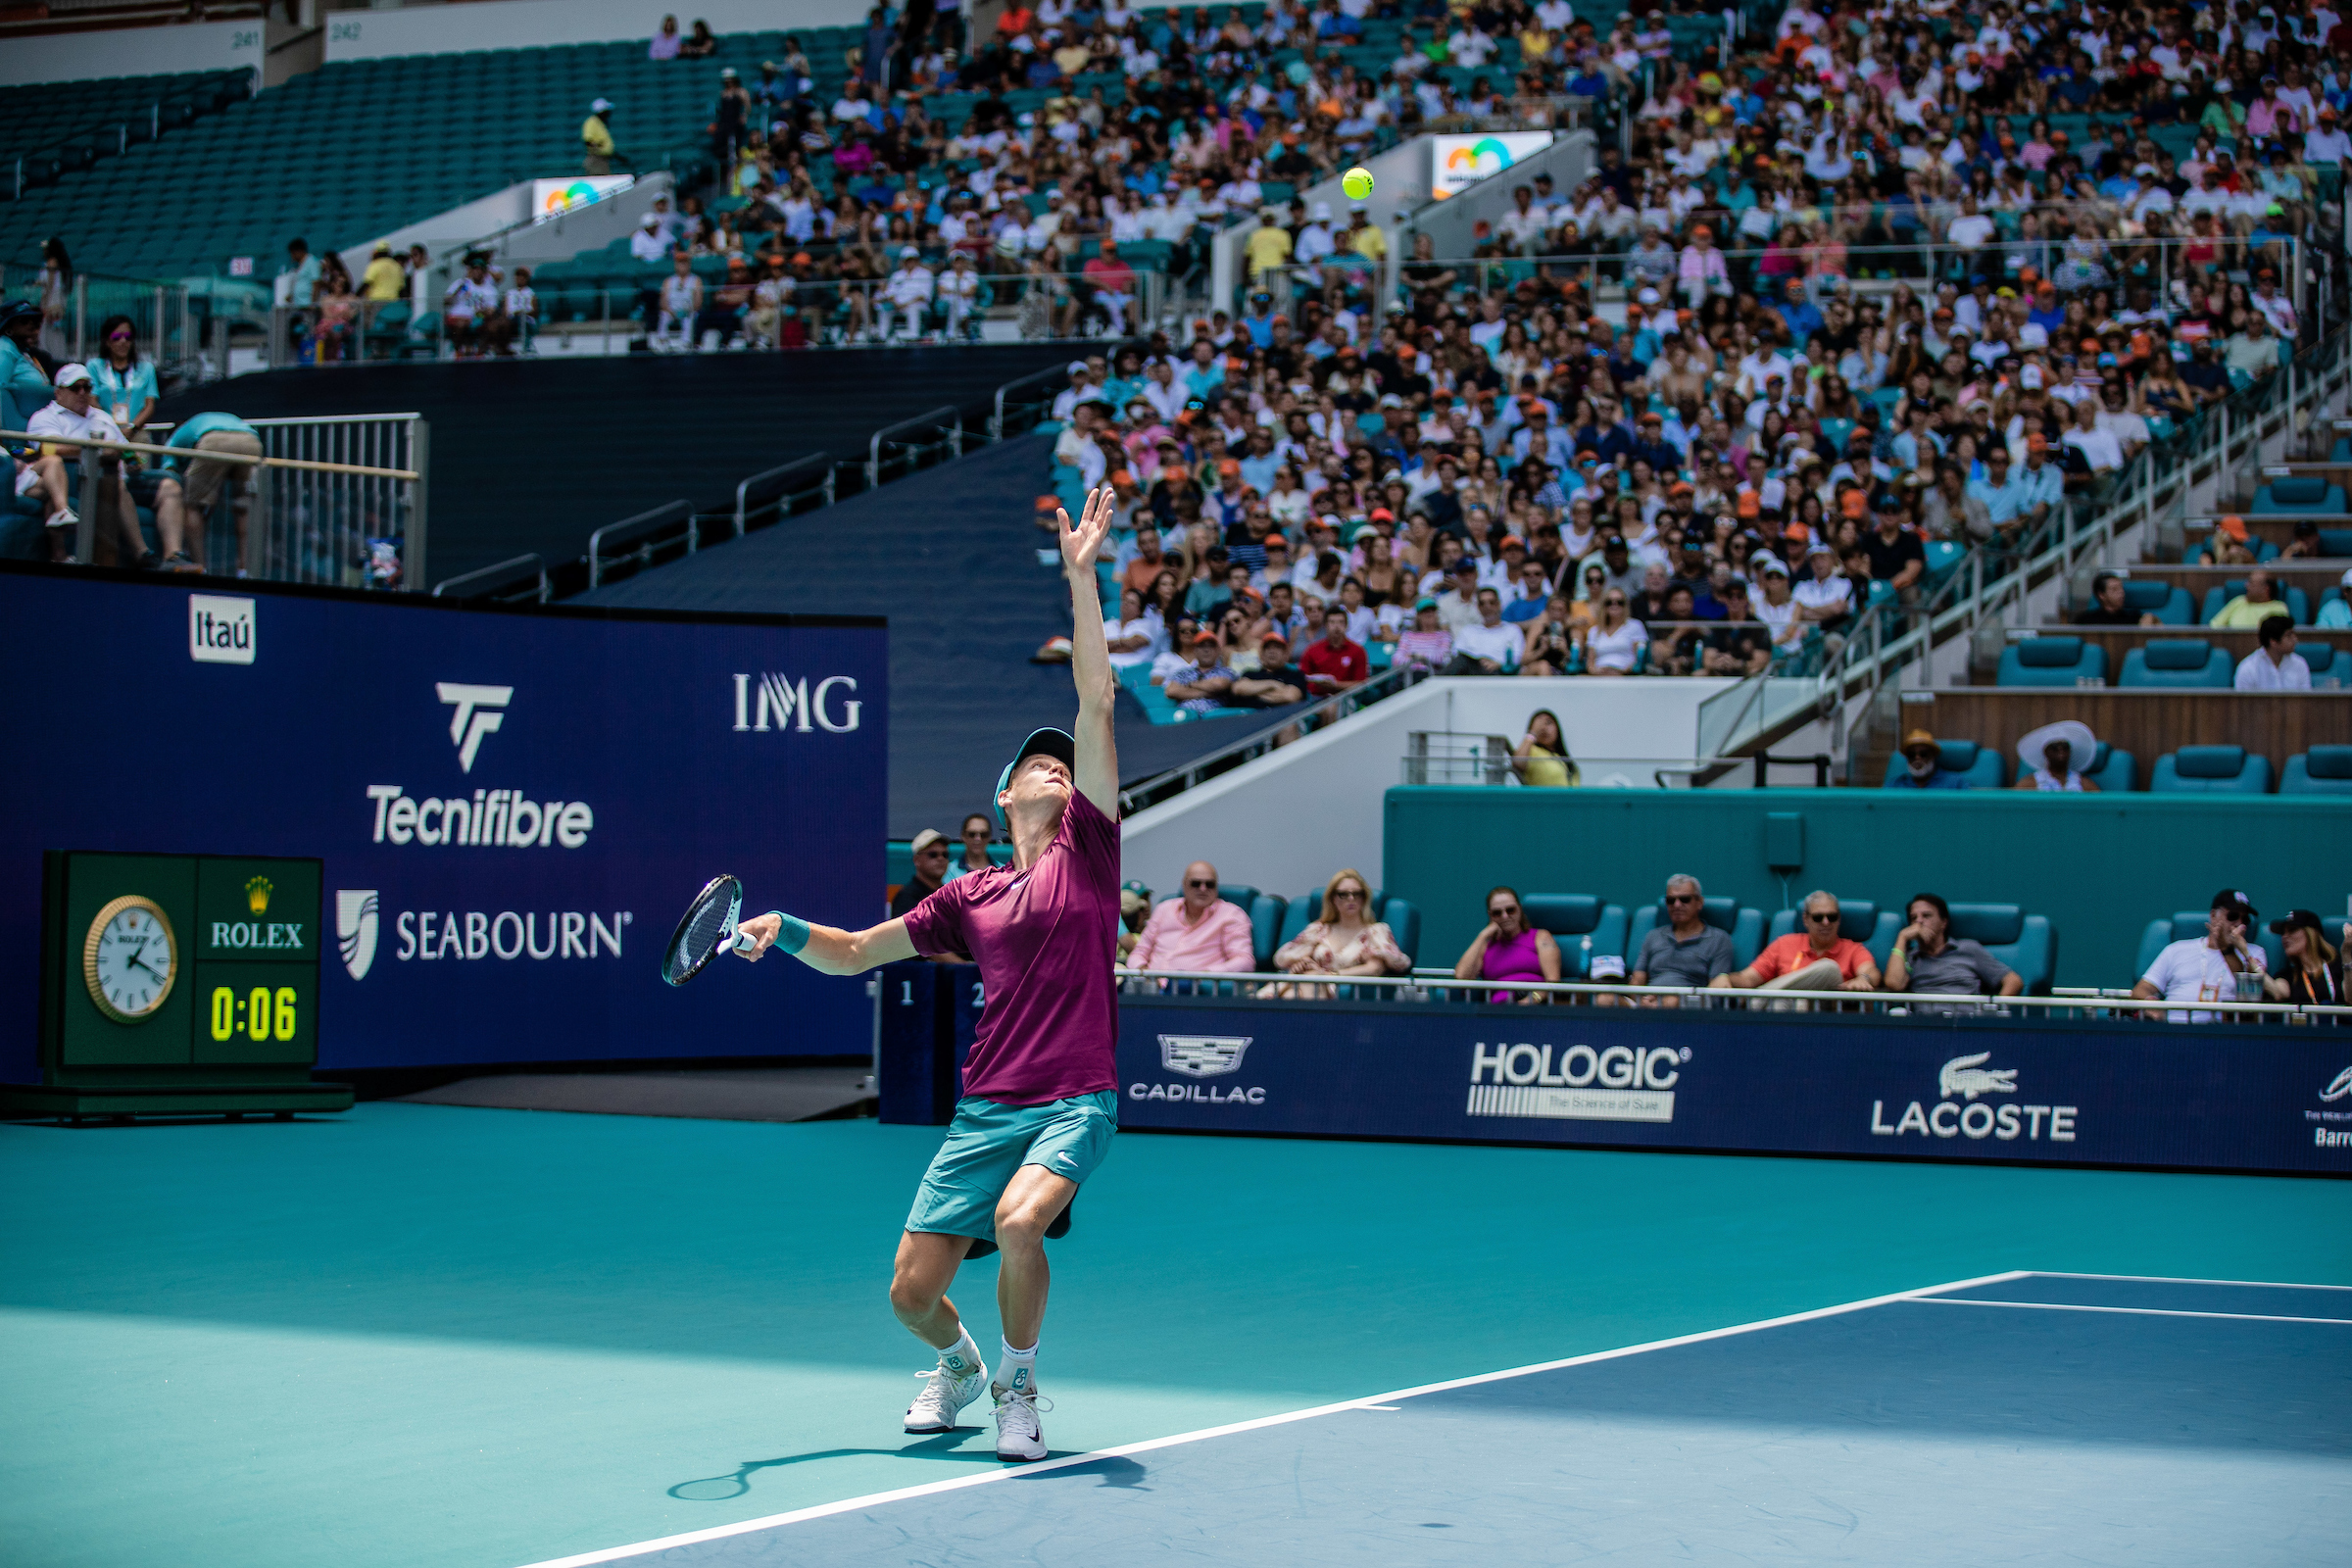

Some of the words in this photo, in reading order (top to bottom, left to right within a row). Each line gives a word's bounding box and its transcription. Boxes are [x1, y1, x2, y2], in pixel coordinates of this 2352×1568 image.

[197, 610, 250, 649] Itaú
[732, 670, 864, 733] IMG
[367, 784, 594, 849] Tecnifibre
[210, 921, 304, 949] ROLEX
[900, 980, 914, 1005] 1
[971, 982, 985, 1007] 2
[211, 986, 298, 1042] 0:06
[1129, 1082, 1267, 1105] CADILLAC
[1871, 1100, 2079, 1142] LACOSTE
